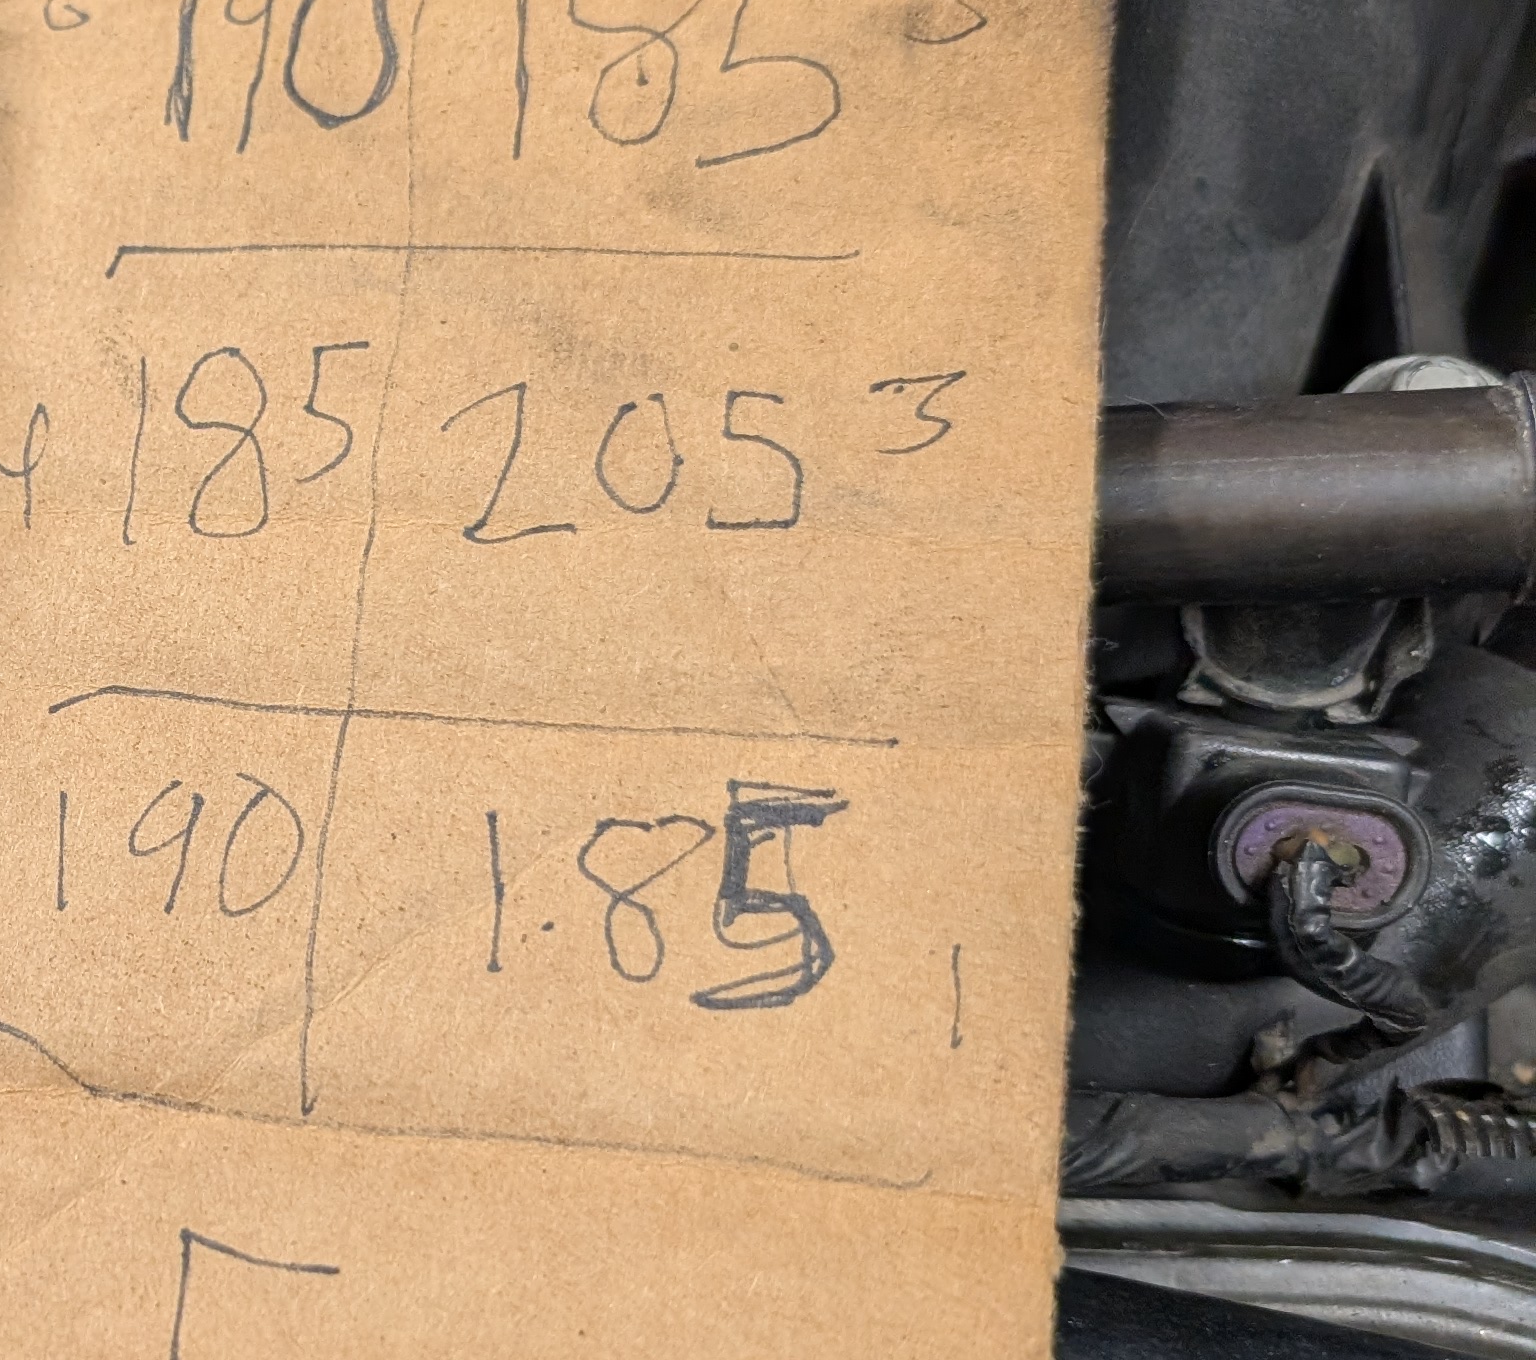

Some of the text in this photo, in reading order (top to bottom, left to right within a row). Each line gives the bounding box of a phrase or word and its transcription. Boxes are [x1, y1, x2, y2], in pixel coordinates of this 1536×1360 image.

[124, 342, 370, 546] 185
[440, 384, 805, 543] 205
[869, 370, 968, 454] 3
[58, 772, 306, 917] 190
